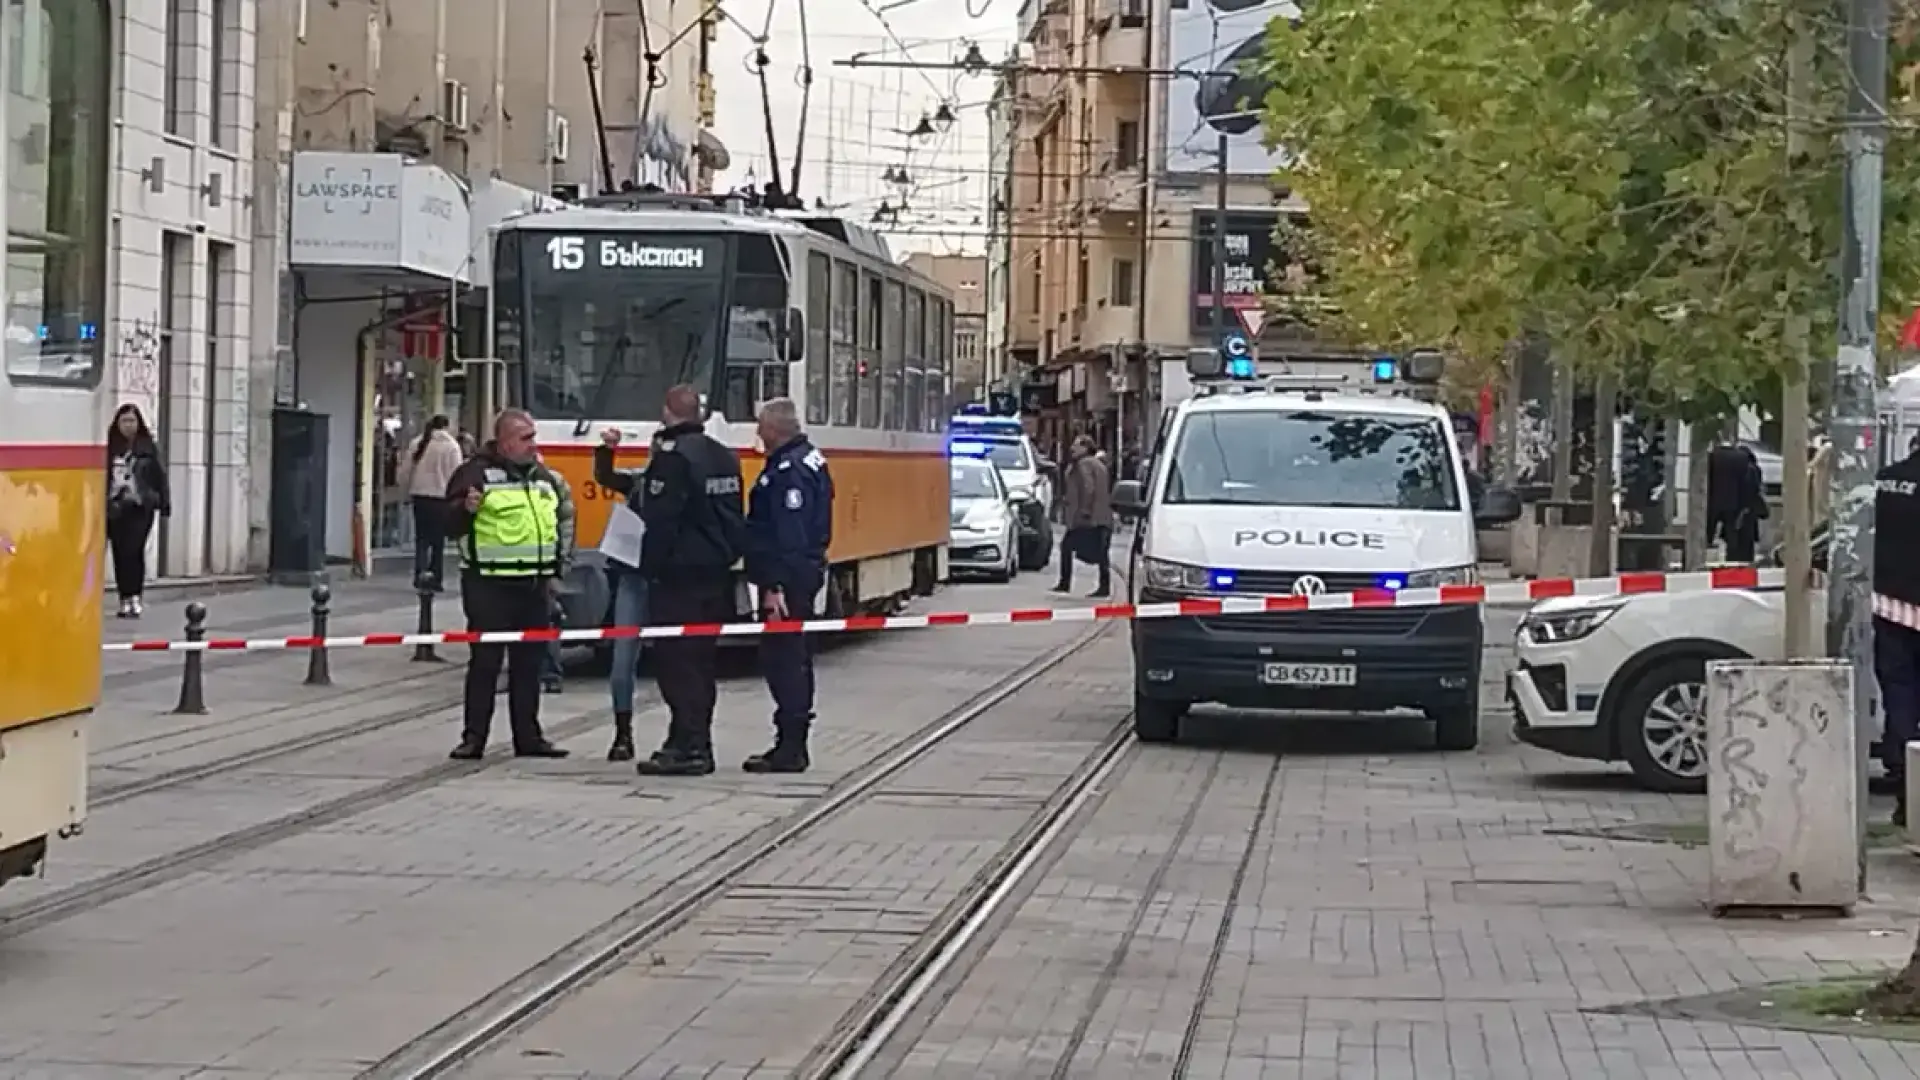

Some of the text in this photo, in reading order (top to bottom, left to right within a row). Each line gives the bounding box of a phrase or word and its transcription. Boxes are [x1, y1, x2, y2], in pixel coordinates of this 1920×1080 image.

[297, 183, 397, 199] LAWSPACE
[546, 236, 585, 270] 15
[1234, 530, 1386, 549] POLICE
